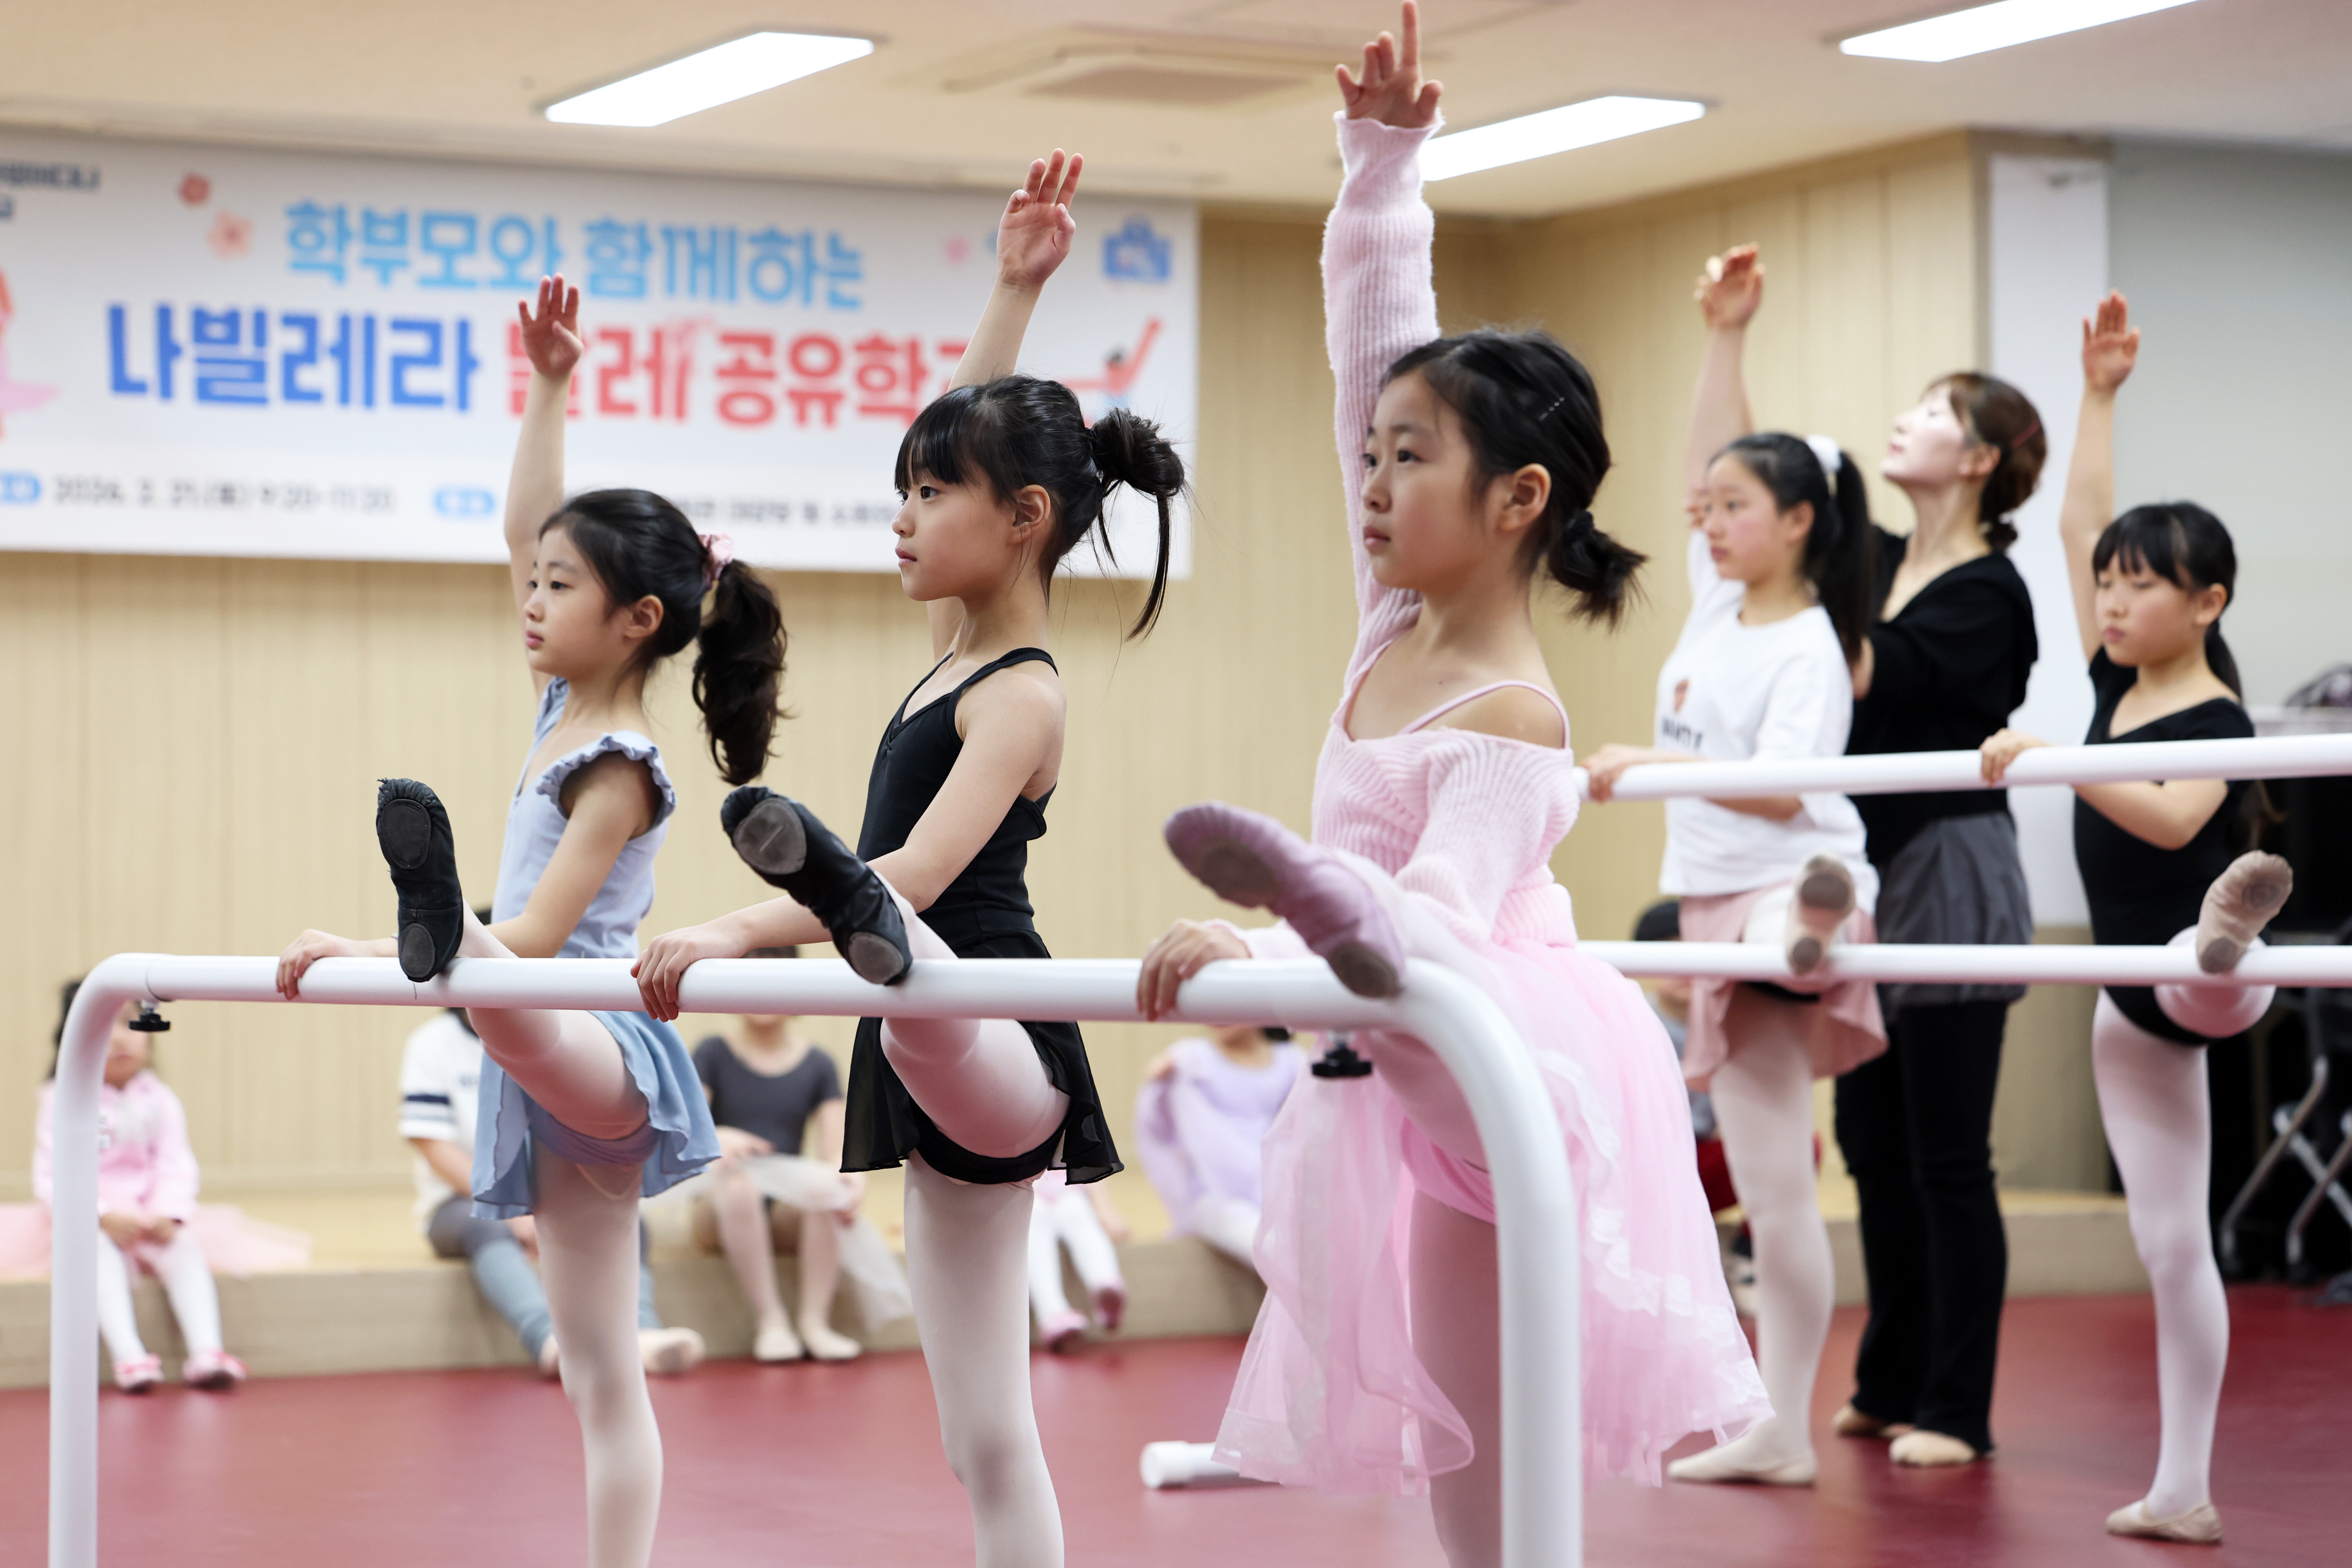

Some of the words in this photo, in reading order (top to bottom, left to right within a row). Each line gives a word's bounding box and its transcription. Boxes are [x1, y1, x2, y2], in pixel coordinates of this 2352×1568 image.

[285, 200, 563, 291] 학부모와
[584, 218, 862, 310] 함께하는
[107, 304, 482, 412] 나빌레라
[509, 319, 691, 421] 레
[716, 331, 970, 429] 공유학
